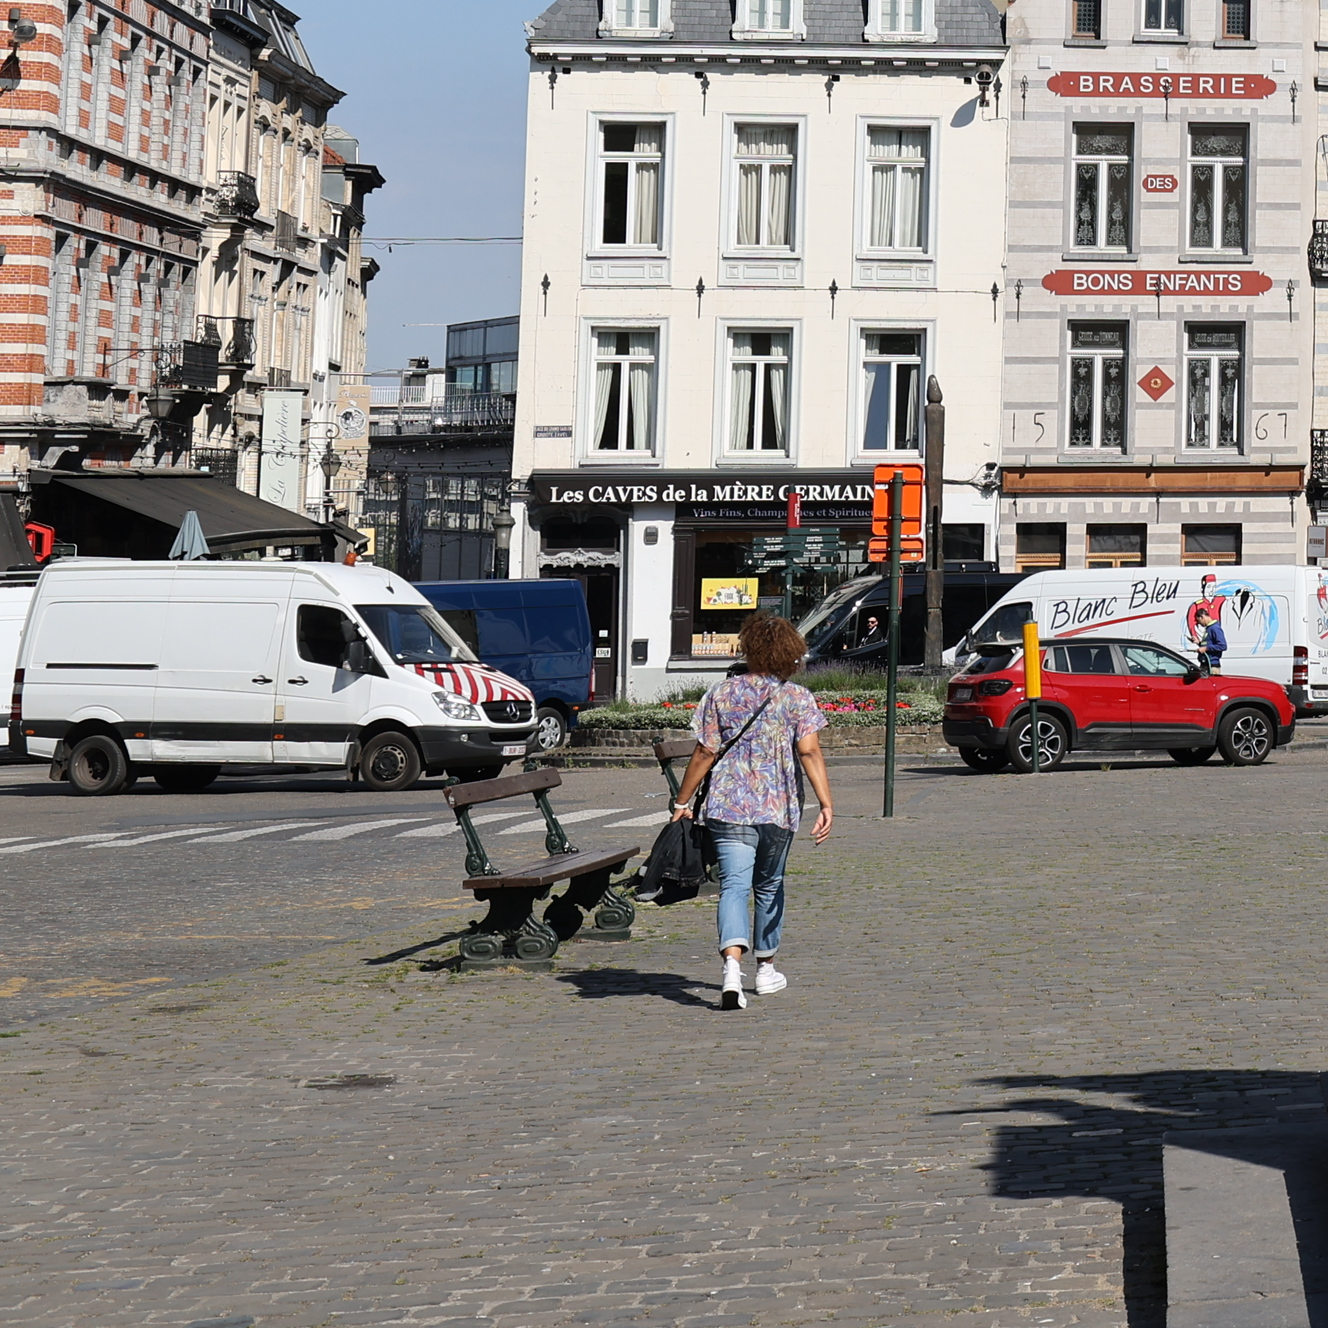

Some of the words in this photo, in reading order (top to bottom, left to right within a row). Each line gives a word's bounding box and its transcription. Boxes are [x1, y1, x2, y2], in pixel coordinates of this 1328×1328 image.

[1079, 75, 1246, 95] BRASSERIE
[1147, 176, 1173, 189] DES
[1073, 273, 1133, 291] BONS
[1146, 273, 1242, 291] ENFANTS
[1254, 412, 1288, 441] 67
[550, 486, 584, 503] Les
[588, 485, 657, 503] CAVES
[662, 484, 686, 502] de
[690, 484, 708, 502] la
[713, 481, 774, 502] MÈRE
[693, 509, 717, 518] Vins
[719, 509, 745, 518] Fins,
[816, 509, 827, 517] et
[829, 508, 874, 519] Spiritue
[1050, 597, 1118, 630] Blanc
[1128, 577, 1180, 610] Bleu
